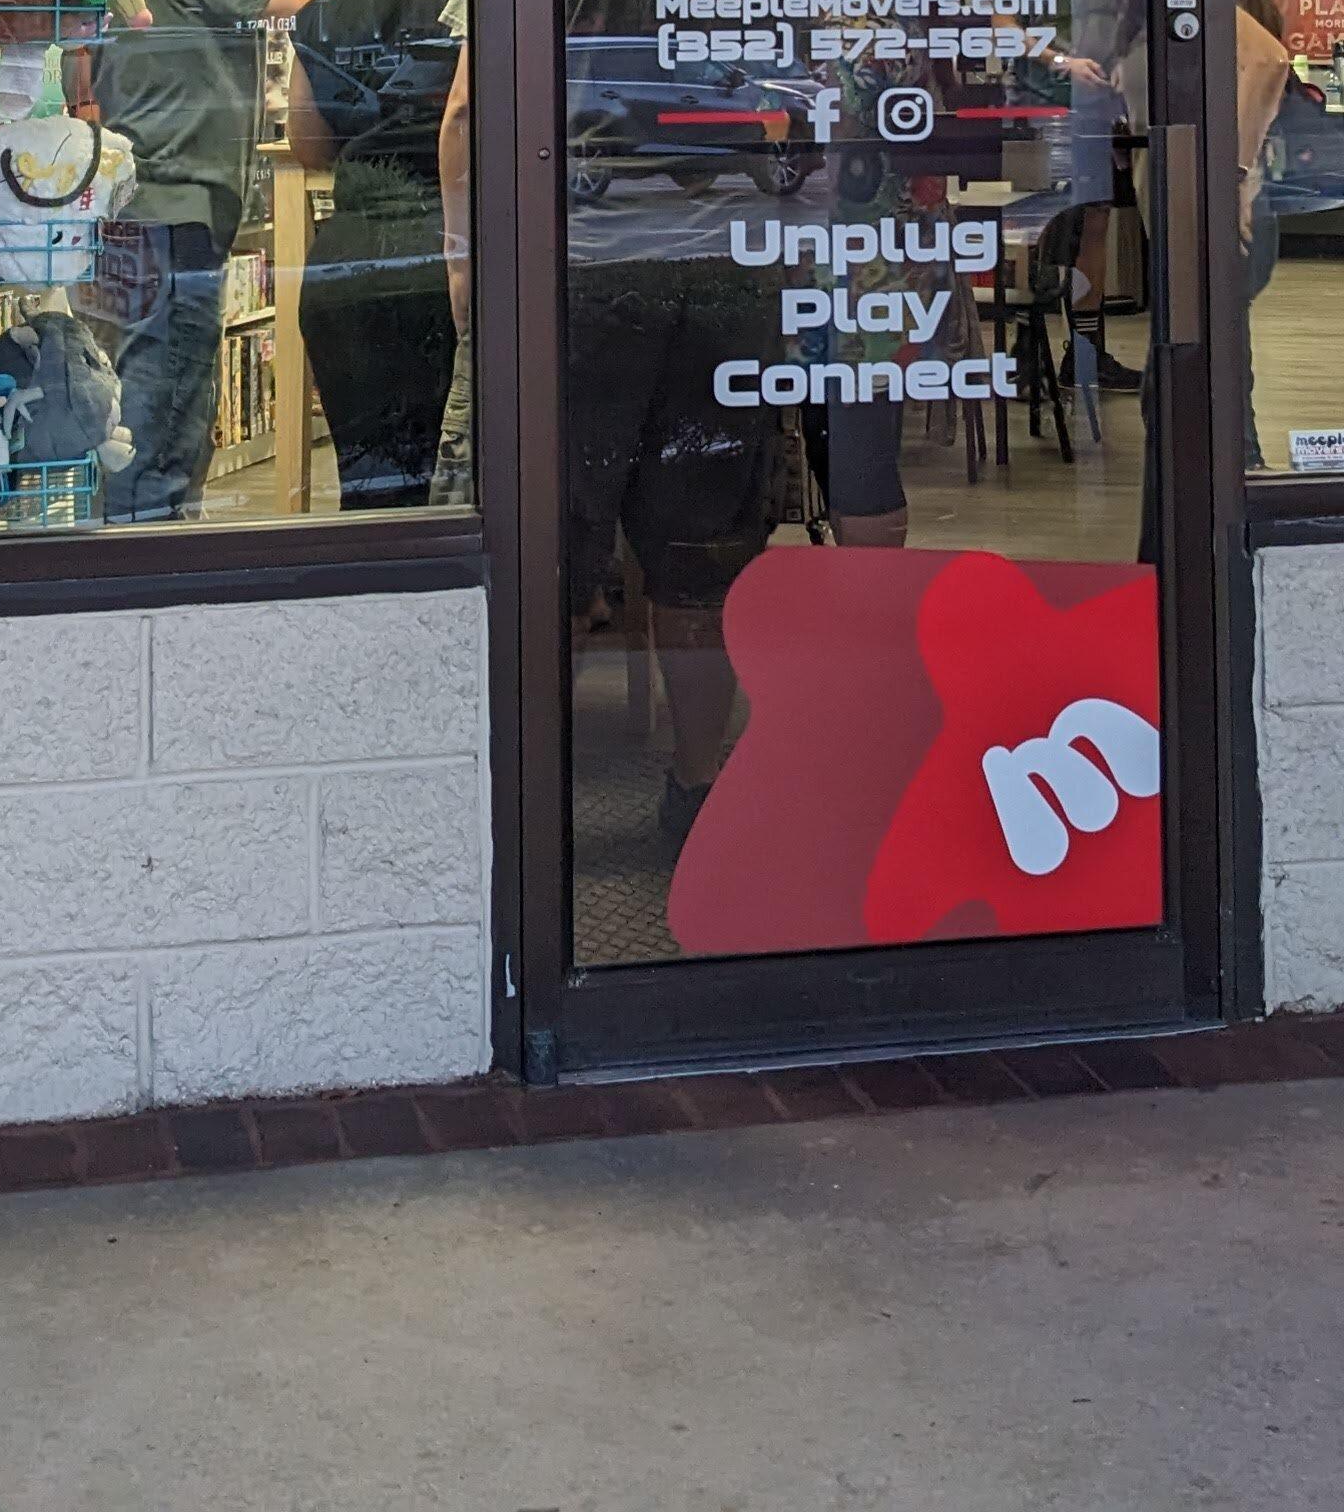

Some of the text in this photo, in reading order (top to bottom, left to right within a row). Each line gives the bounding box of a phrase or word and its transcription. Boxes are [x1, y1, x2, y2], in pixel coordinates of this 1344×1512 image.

[657, 22, 1057, 70] (352) 572-5637
[729, 217, 998, 276] Unplug
[781, 288, 952, 344] Play
[713, 352, 1017, 408] Connect
